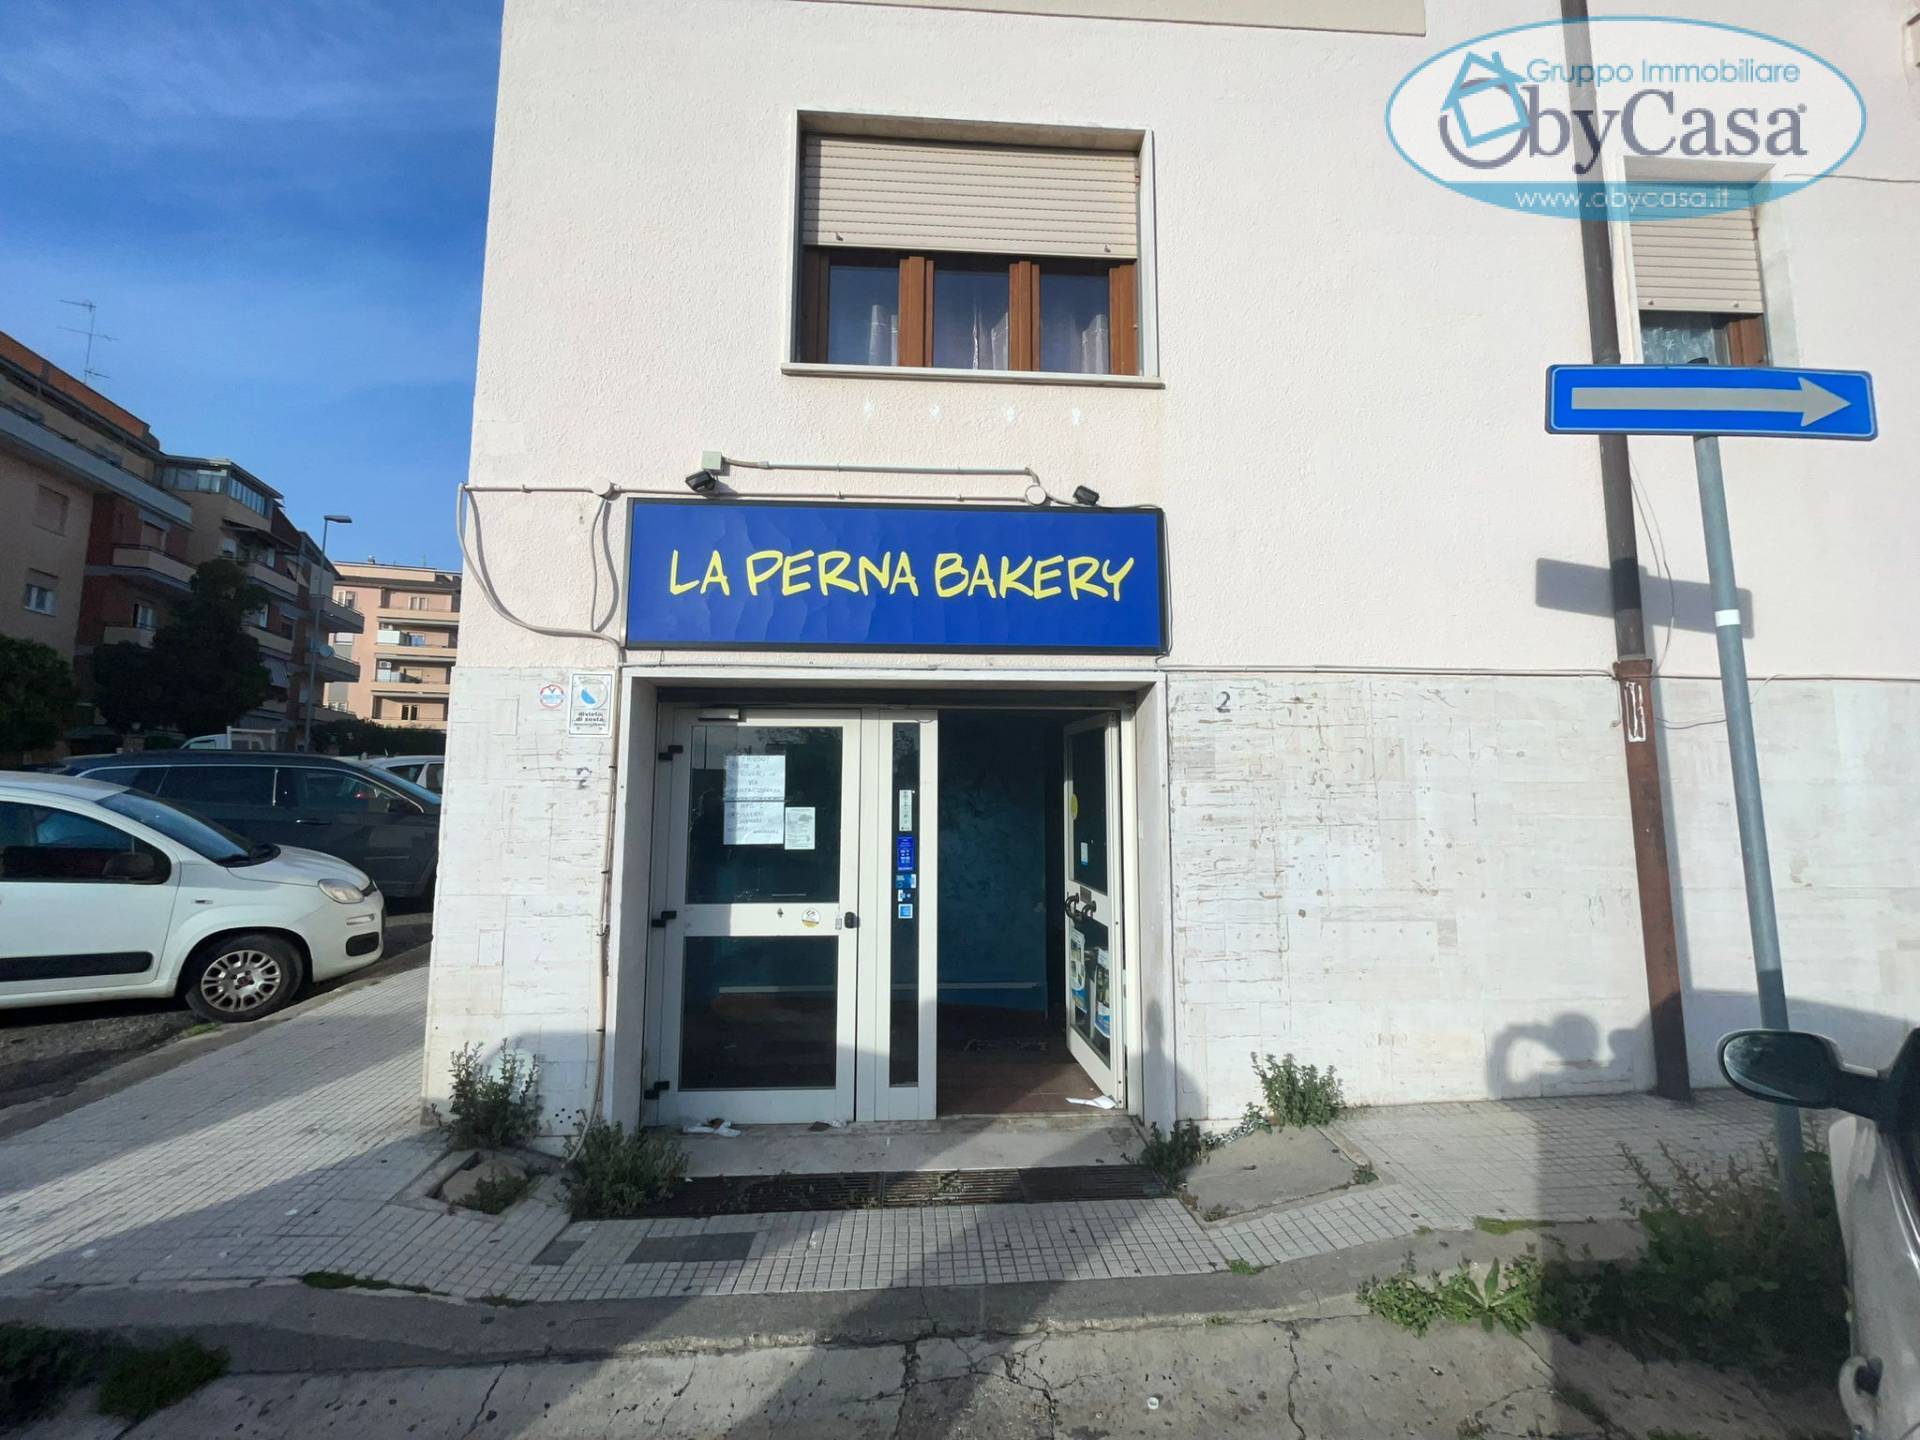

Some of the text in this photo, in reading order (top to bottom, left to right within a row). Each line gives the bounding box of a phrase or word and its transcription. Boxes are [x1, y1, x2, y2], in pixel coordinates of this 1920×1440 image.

[669, 549, 1134, 602] LA PERNA BAKERY
[1216, 691, 1231, 713] 2
